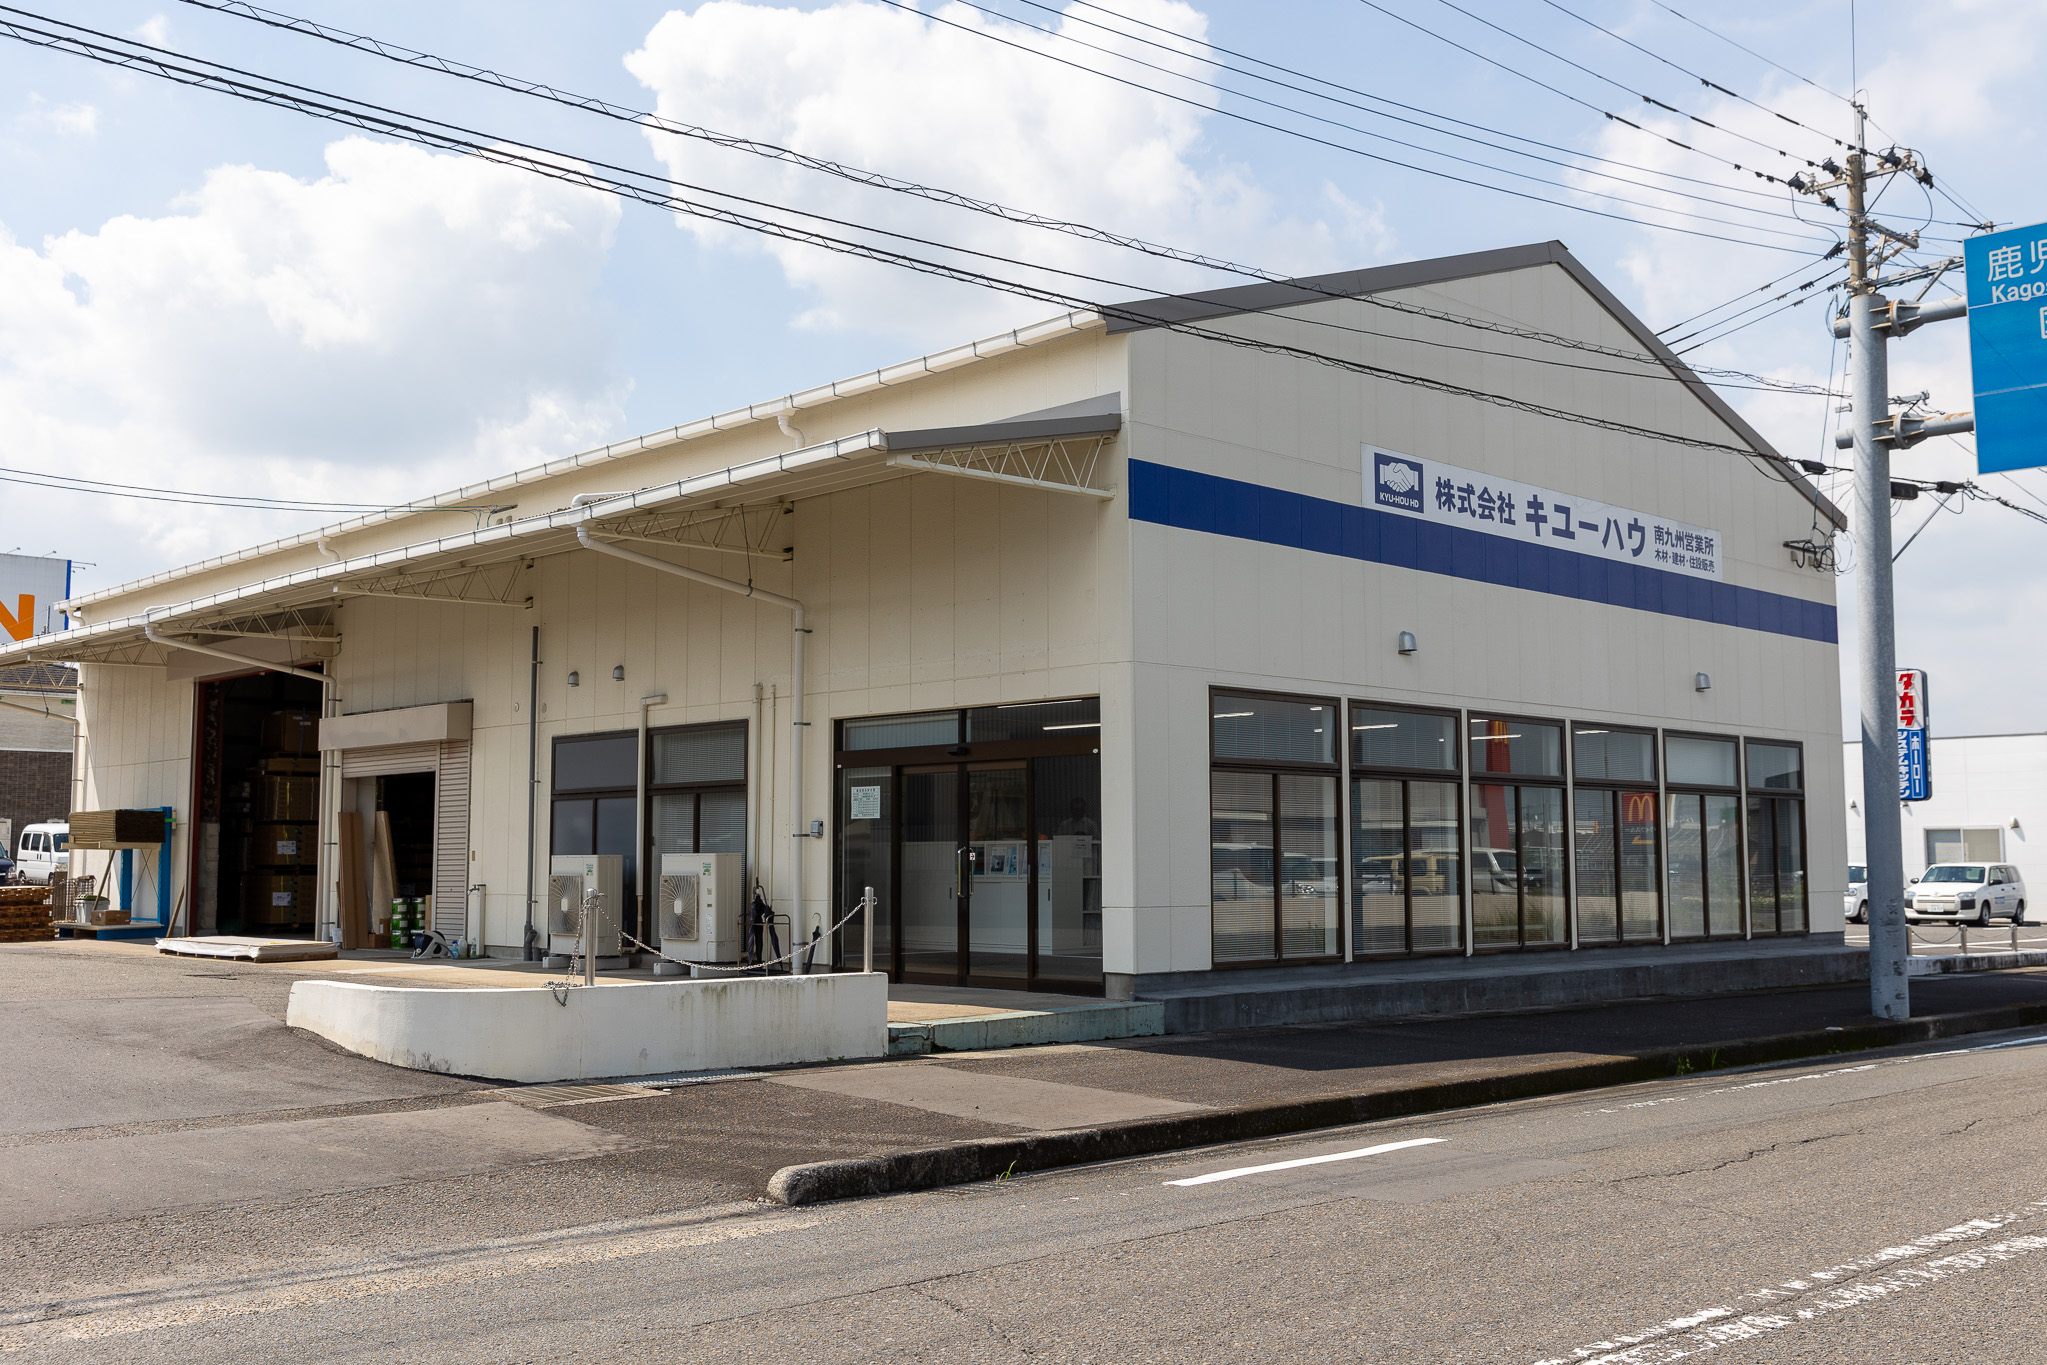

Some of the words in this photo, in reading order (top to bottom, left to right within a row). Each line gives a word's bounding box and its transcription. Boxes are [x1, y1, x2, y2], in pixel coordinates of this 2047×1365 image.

[1992, 281, 2047, 304] Kago
[1380, 492, 1409, 505] KYU-HOU
[1410, 499, 1419, 508] HD
[1435, 476, 1516, 526] 株式会社
[1653, 525, 1714, 557] 南九州営業所
[1899, 673, 1915, 727] タカラ
[1911, 735, 1920, 793] ホーロー
